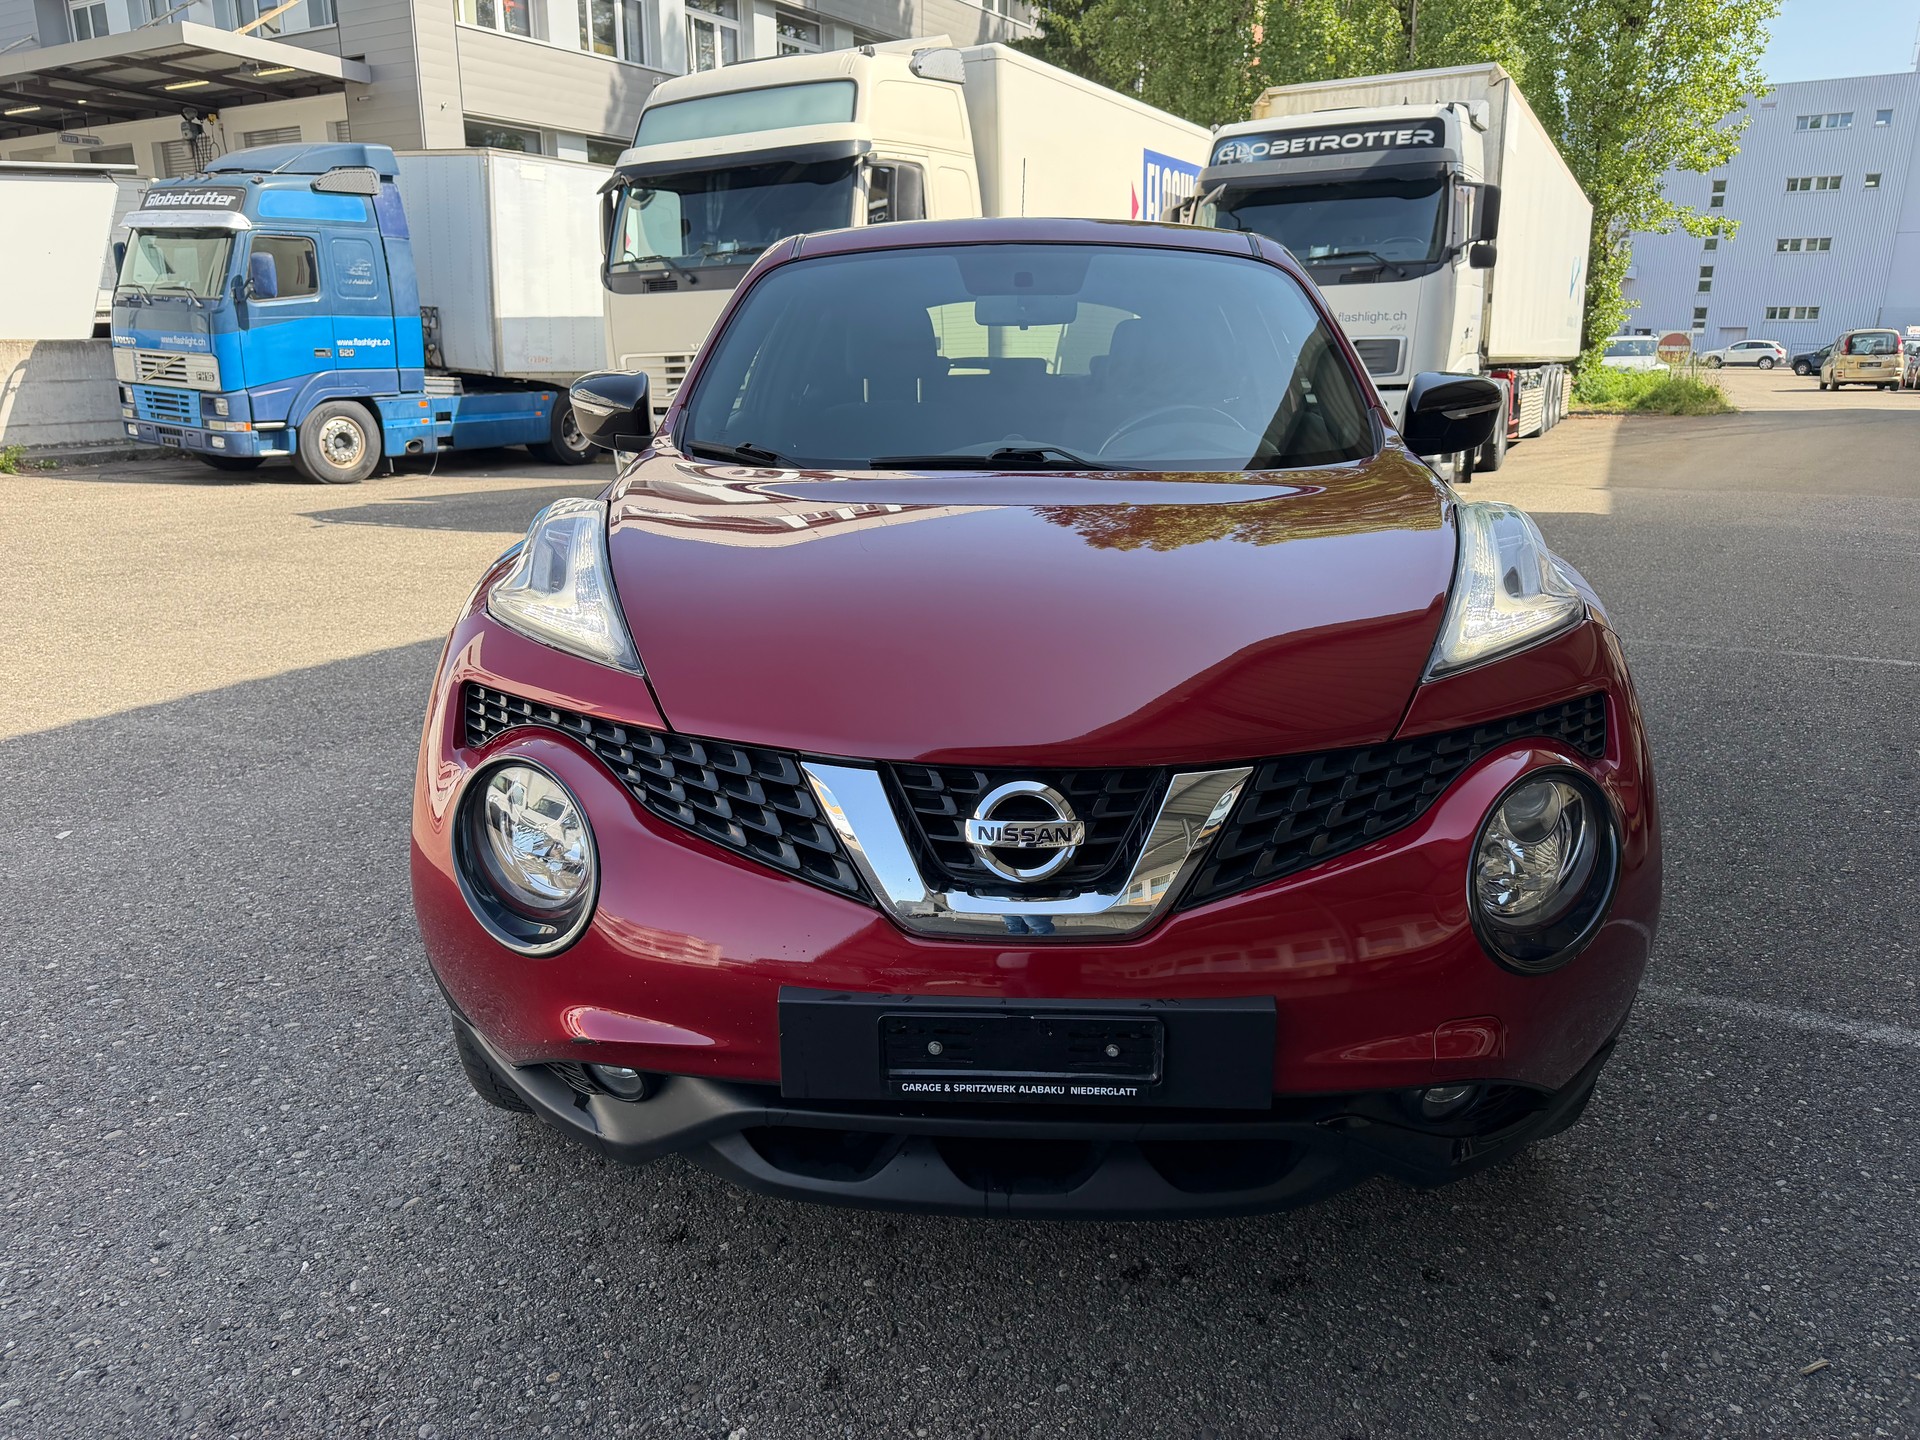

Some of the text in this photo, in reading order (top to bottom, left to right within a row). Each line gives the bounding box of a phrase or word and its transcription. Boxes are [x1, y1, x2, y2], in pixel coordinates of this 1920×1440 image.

[1218, 129, 1435, 161] GLOBETROTTER
[144, 191, 236, 207] Globetrotter
[1338, 311, 1408, 325] flashlight.ch
[114, 335, 137, 345] VOLVO
[160, 335, 207, 348] www.flashlight.ch
[336, 338, 391, 348] www.flashlight.ch
[339, 348, 355, 357] 520
[978, 825, 1072, 843] NISSAN
[901, 1083, 1138, 1097] GARAGE & SPRITZWERK ALABAKU NIEDERGLATT
